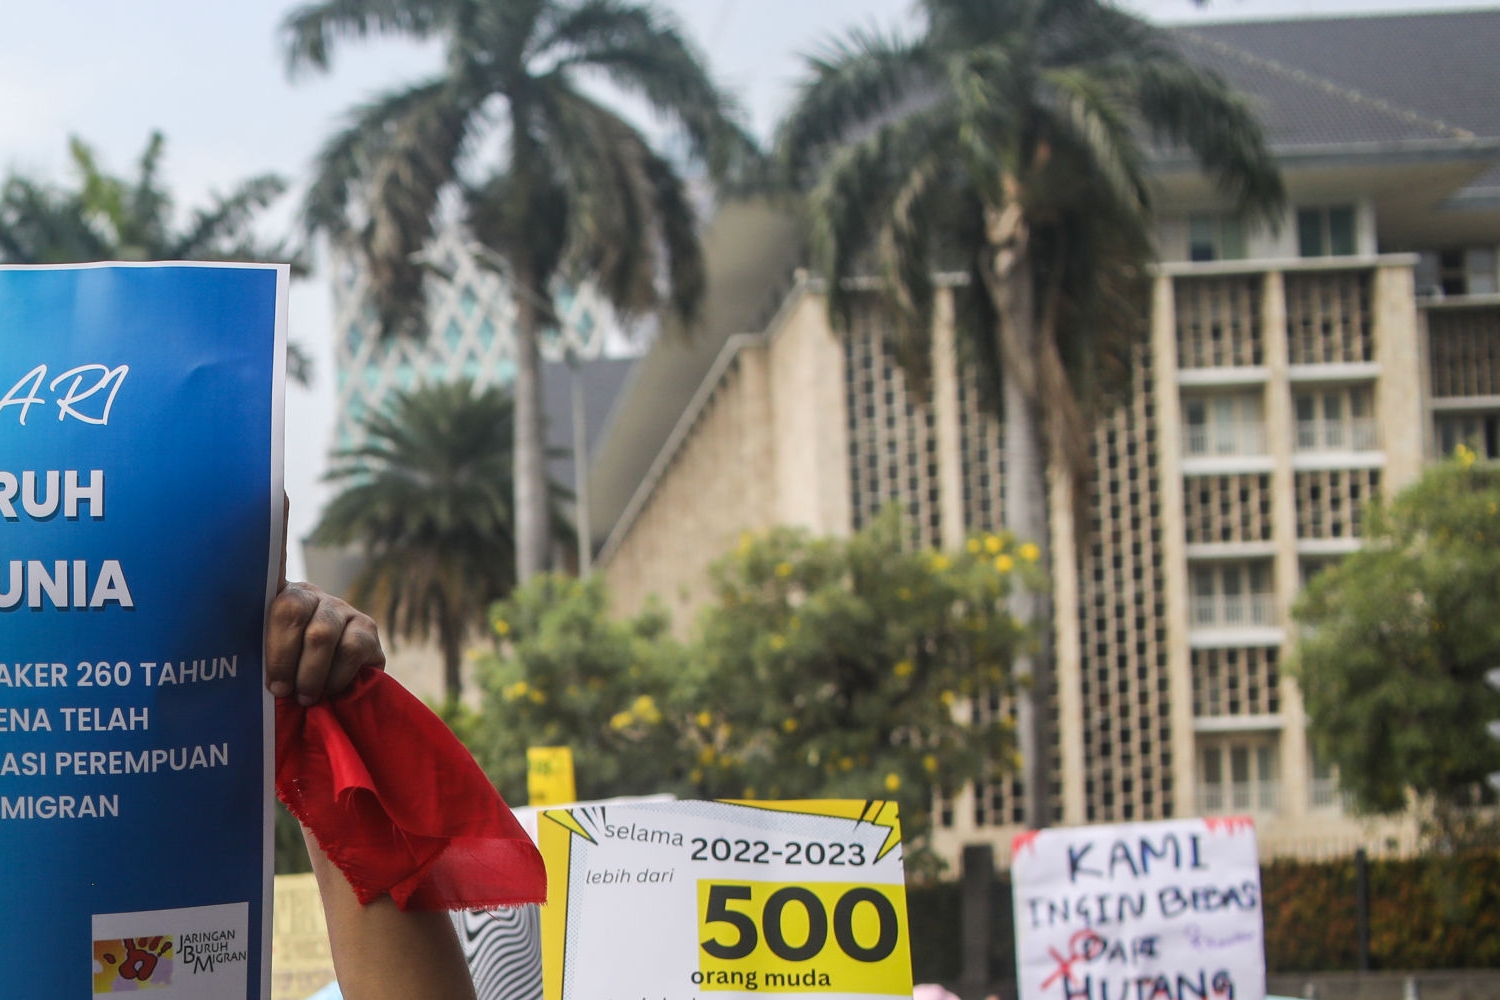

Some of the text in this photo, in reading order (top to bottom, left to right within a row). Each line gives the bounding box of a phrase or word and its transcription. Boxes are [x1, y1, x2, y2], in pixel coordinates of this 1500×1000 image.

[77, 661, 132, 687] 260
[138, 655, 239, 686] TAHUN
[60, 706, 149, 731] TELAH
[55, 743, 229, 776] PEREMPUAN
[1, 794, 119, 819] MIGRAN
[604, 821, 866, 866] selama 2022-2023
[1068, 832, 1208, 883] KAMI
[586, 868, 674, 885] lebih dari
[700, 884, 899, 963] 500
[1026, 893, 1145, 930] INGIN
[176, 929, 236, 954] JARINGAN
[183, 942, 228, 965] BURUH
[193, 951, 247, 975] MIGRAN
[690, 969, 831, 990] orang muda
